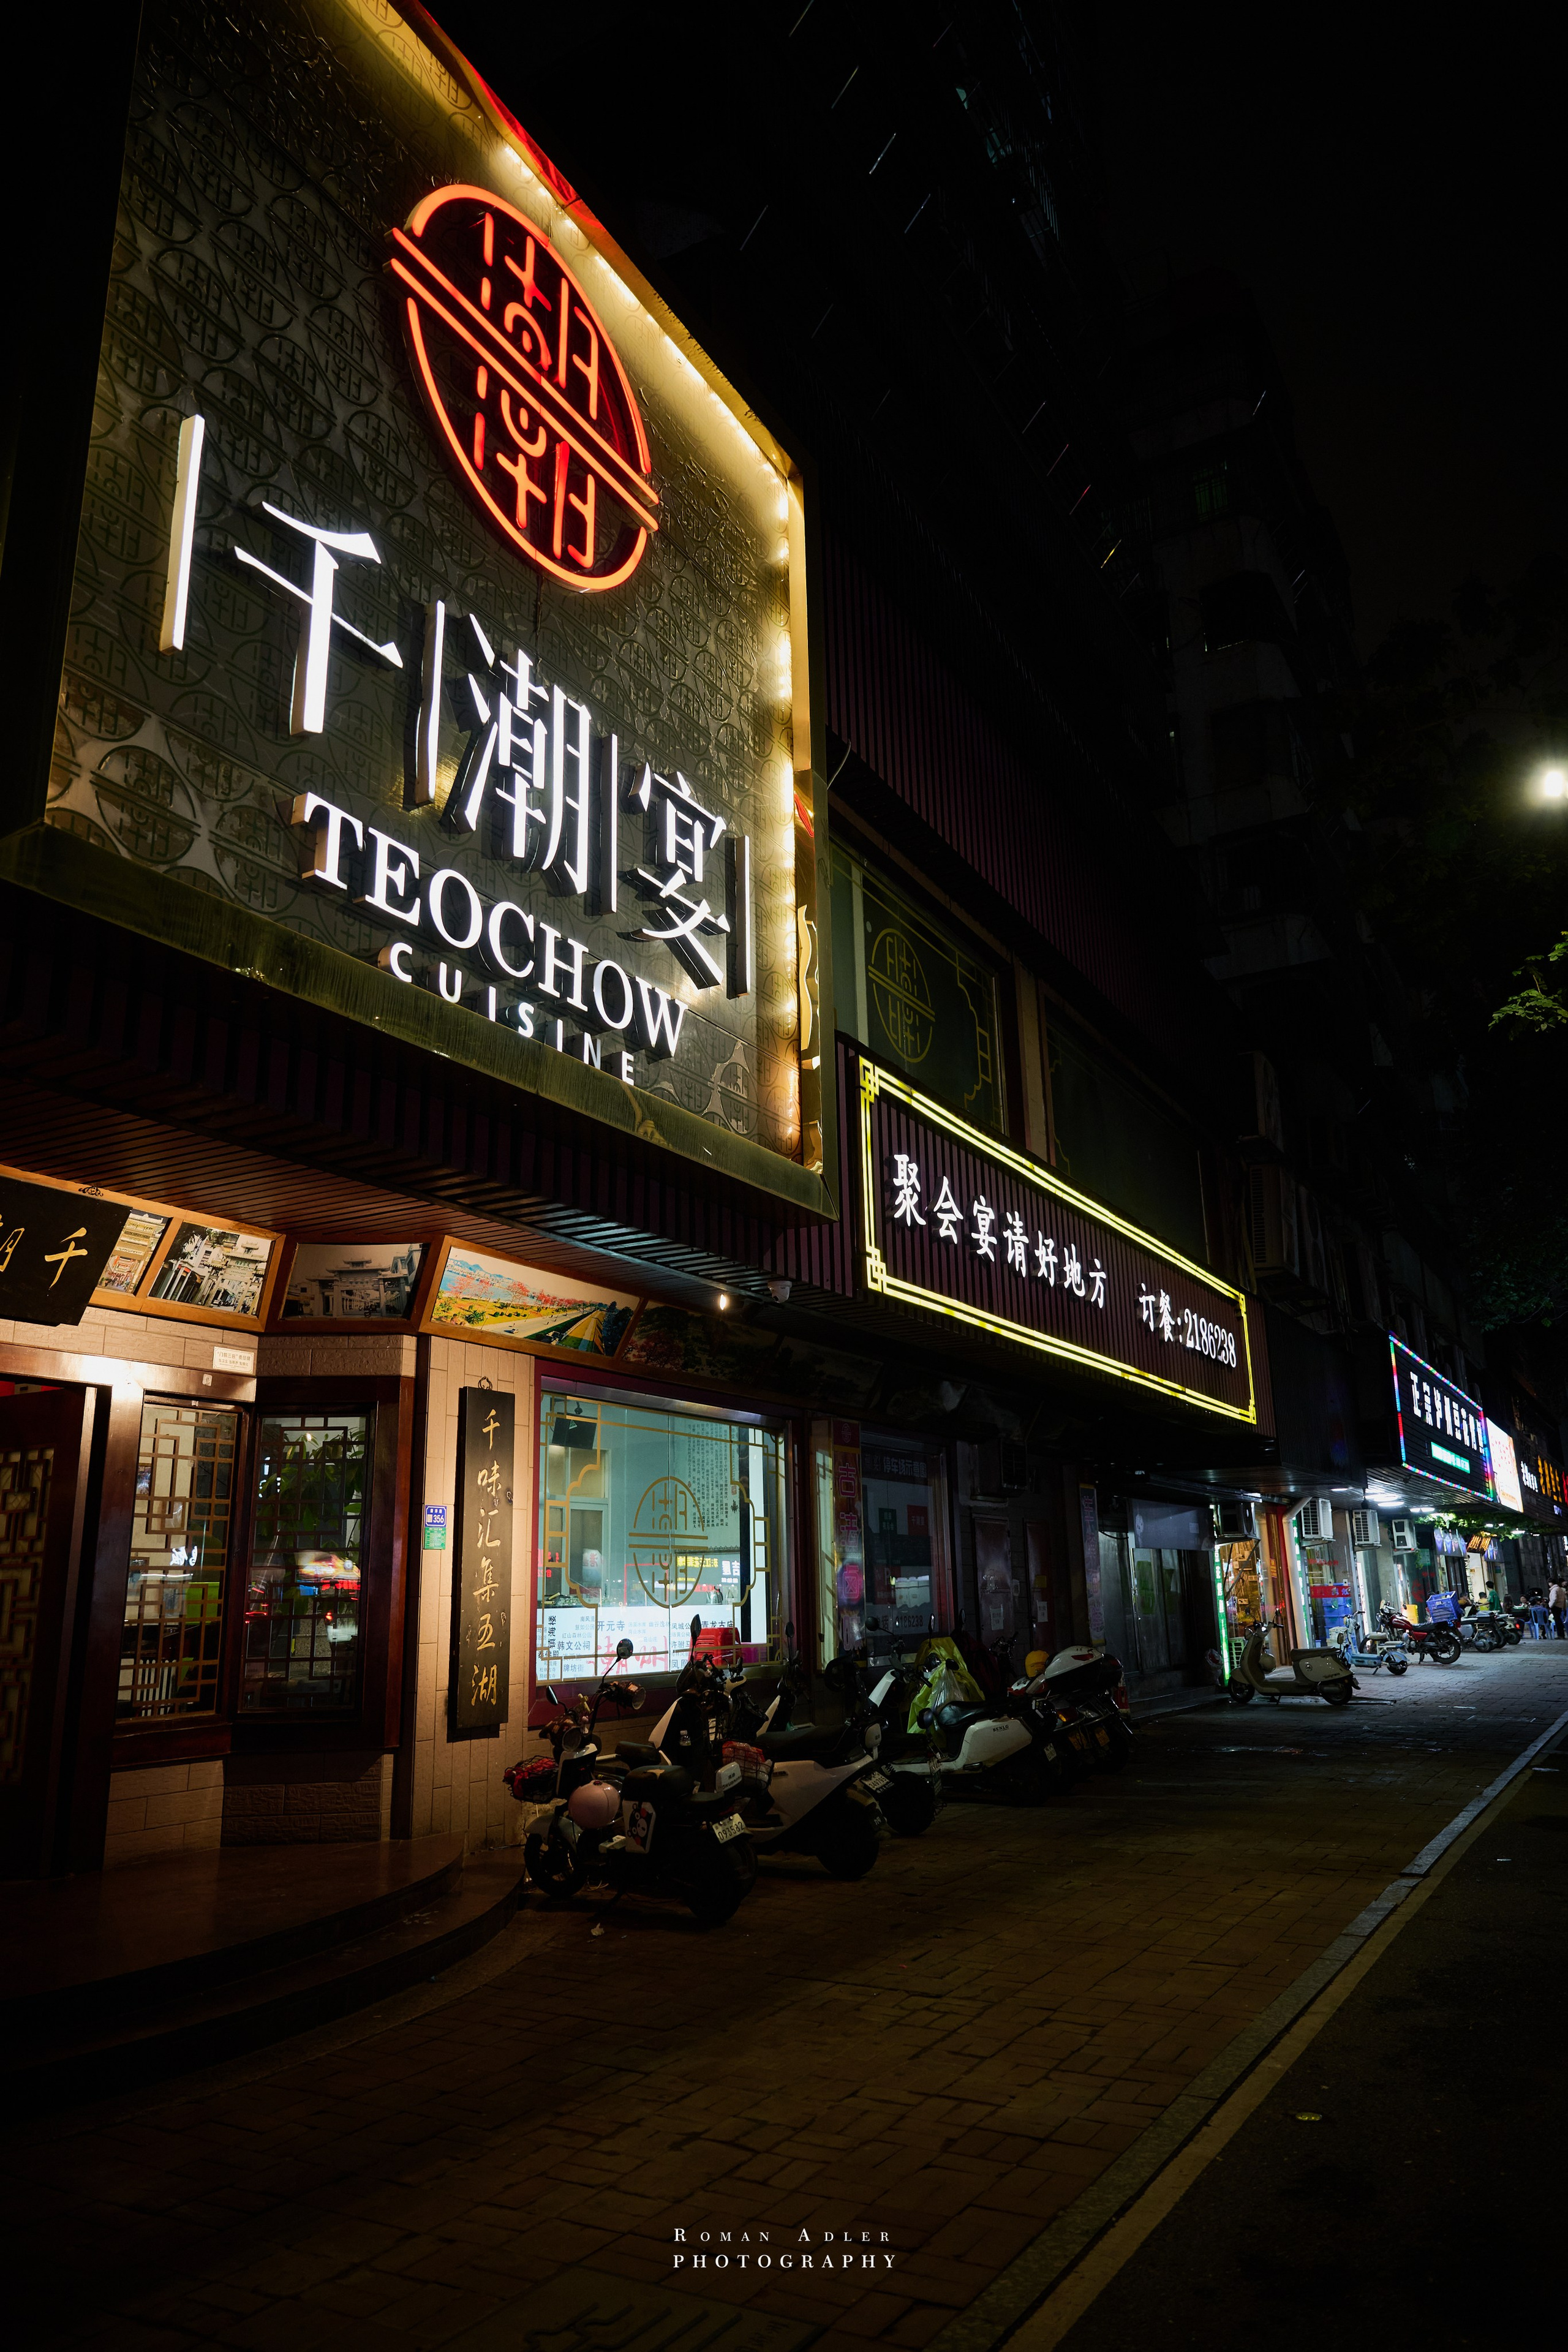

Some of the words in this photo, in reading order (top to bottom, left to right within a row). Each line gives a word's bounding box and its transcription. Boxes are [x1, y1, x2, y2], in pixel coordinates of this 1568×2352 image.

[233, 499, 732, 990] 千潮宴
[303, 792, 690, 1058] TEOCHOW
[389, 946, 636, 1087] CUISINE
[892, 1153, 1107, 1309] 聚会宴请好地方
[1139, 1283, 1237, 1368] 订餐:2186238
[433, 1514, 444, 1523] 356
[557, 1640, 590, 1651] 韩文公祠
[597, 1619, 625, 1632] 开元寺
[718, 1821, 745, 1841] 093582
